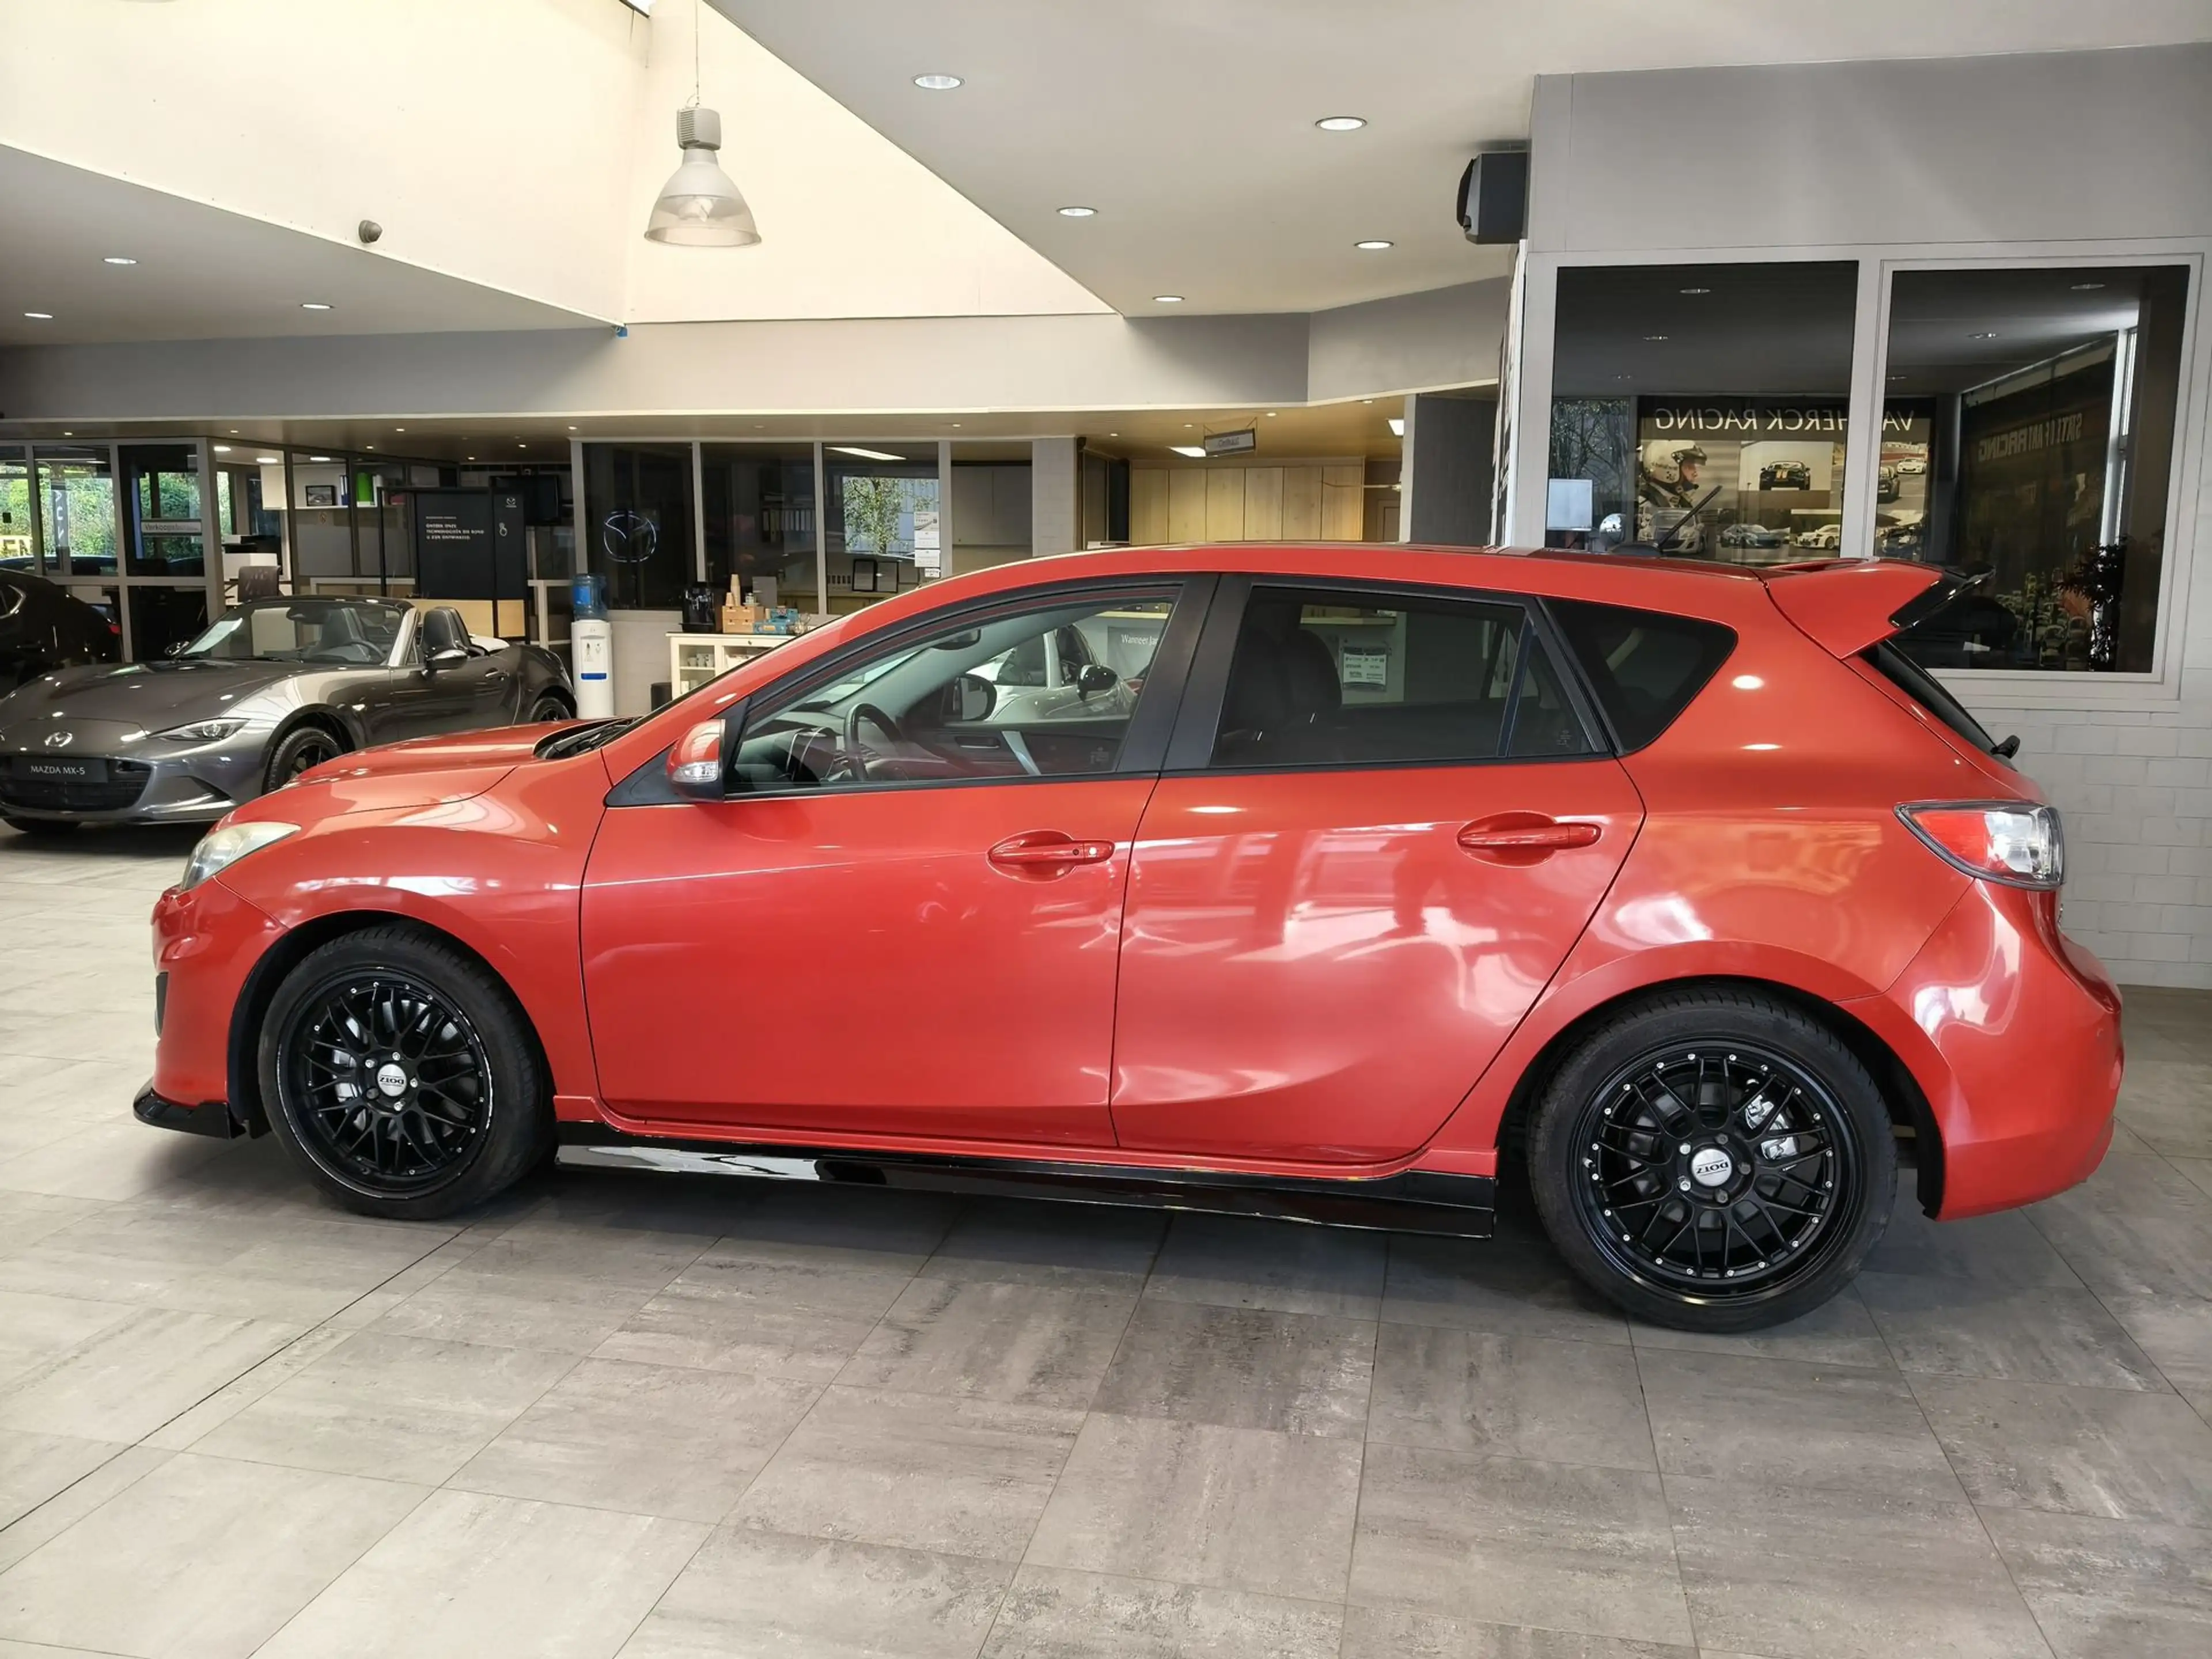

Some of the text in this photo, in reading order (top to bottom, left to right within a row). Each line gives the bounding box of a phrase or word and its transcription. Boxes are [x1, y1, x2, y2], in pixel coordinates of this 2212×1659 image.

[30, 765, 85, 775] MAZDA MX-5
[1696, 1161, 1729, 1174] DOTZ
